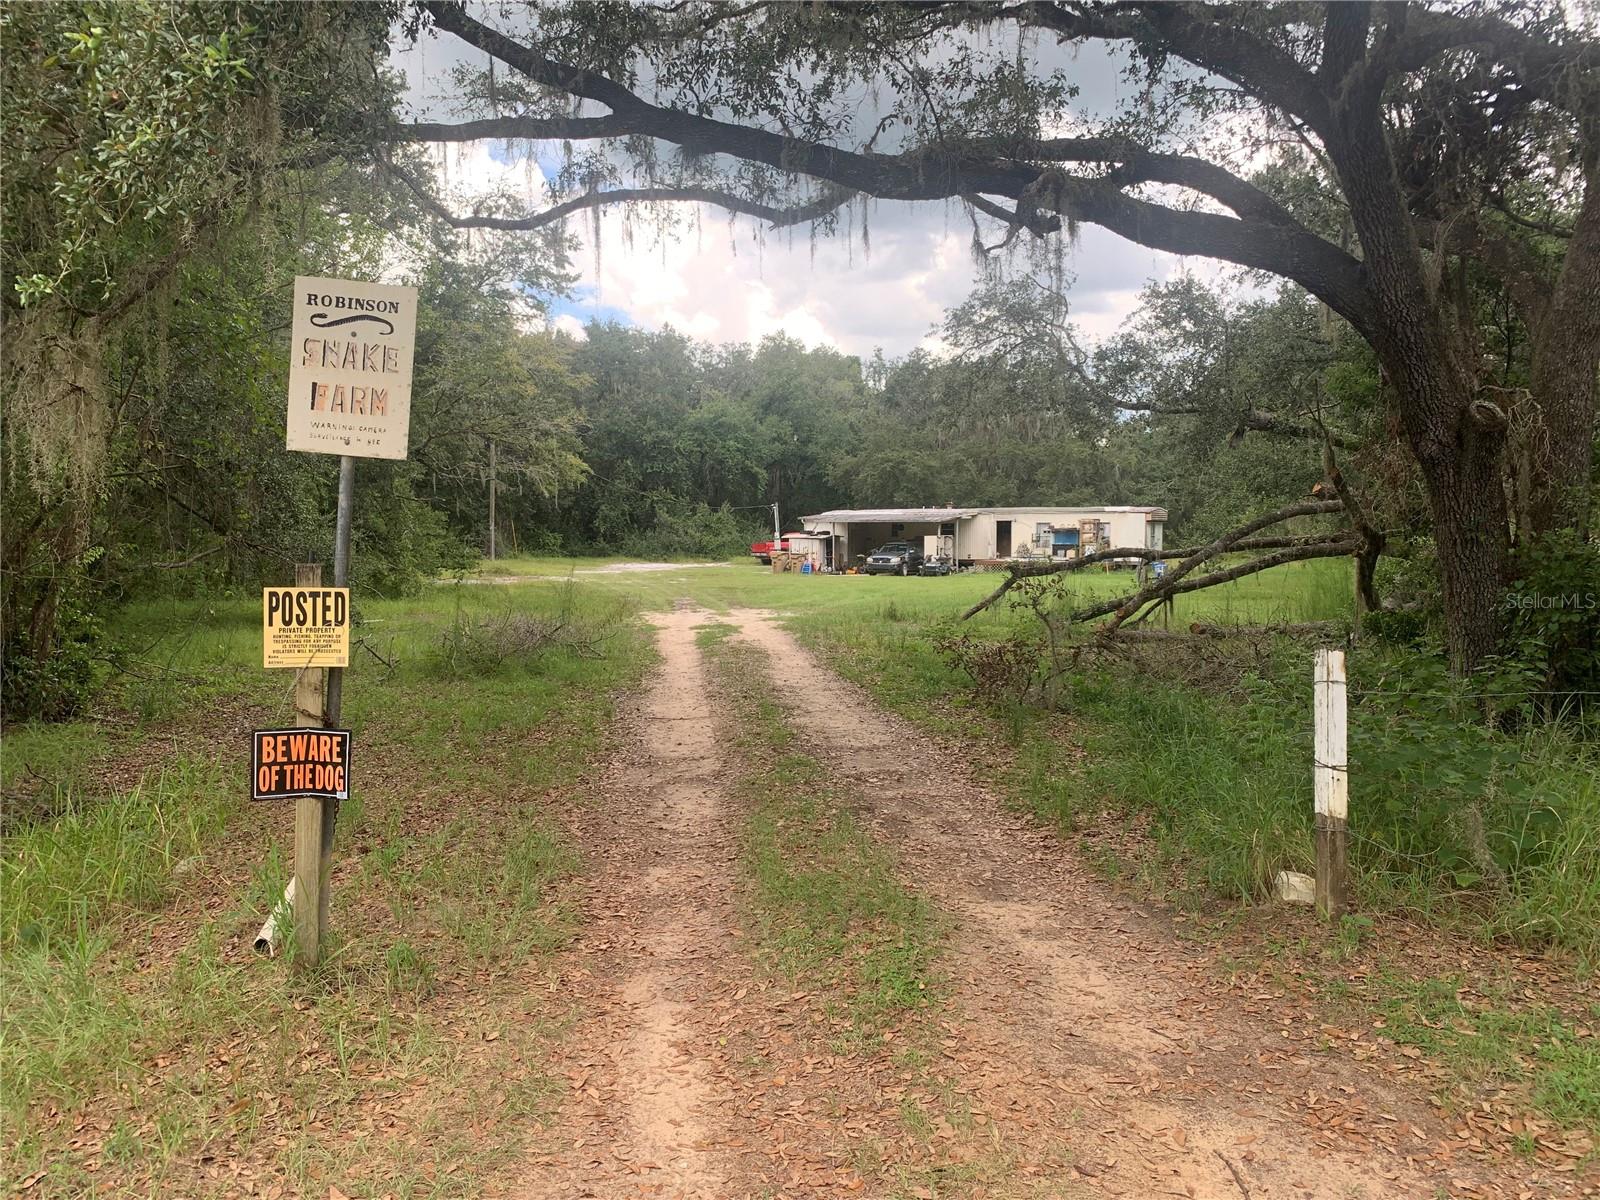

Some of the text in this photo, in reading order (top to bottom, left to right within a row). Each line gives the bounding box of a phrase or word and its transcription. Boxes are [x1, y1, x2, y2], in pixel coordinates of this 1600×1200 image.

[306, 293, 400, 314] ROBINSON
[302, 337, 400, 374] SNAKE
[310, 381, 389, 417] FARM
[268, 591, 346, 627] POSTED
[262, 734, 342, 763] BEWARE
[258, 764, 344, 793] OF THE DOG
